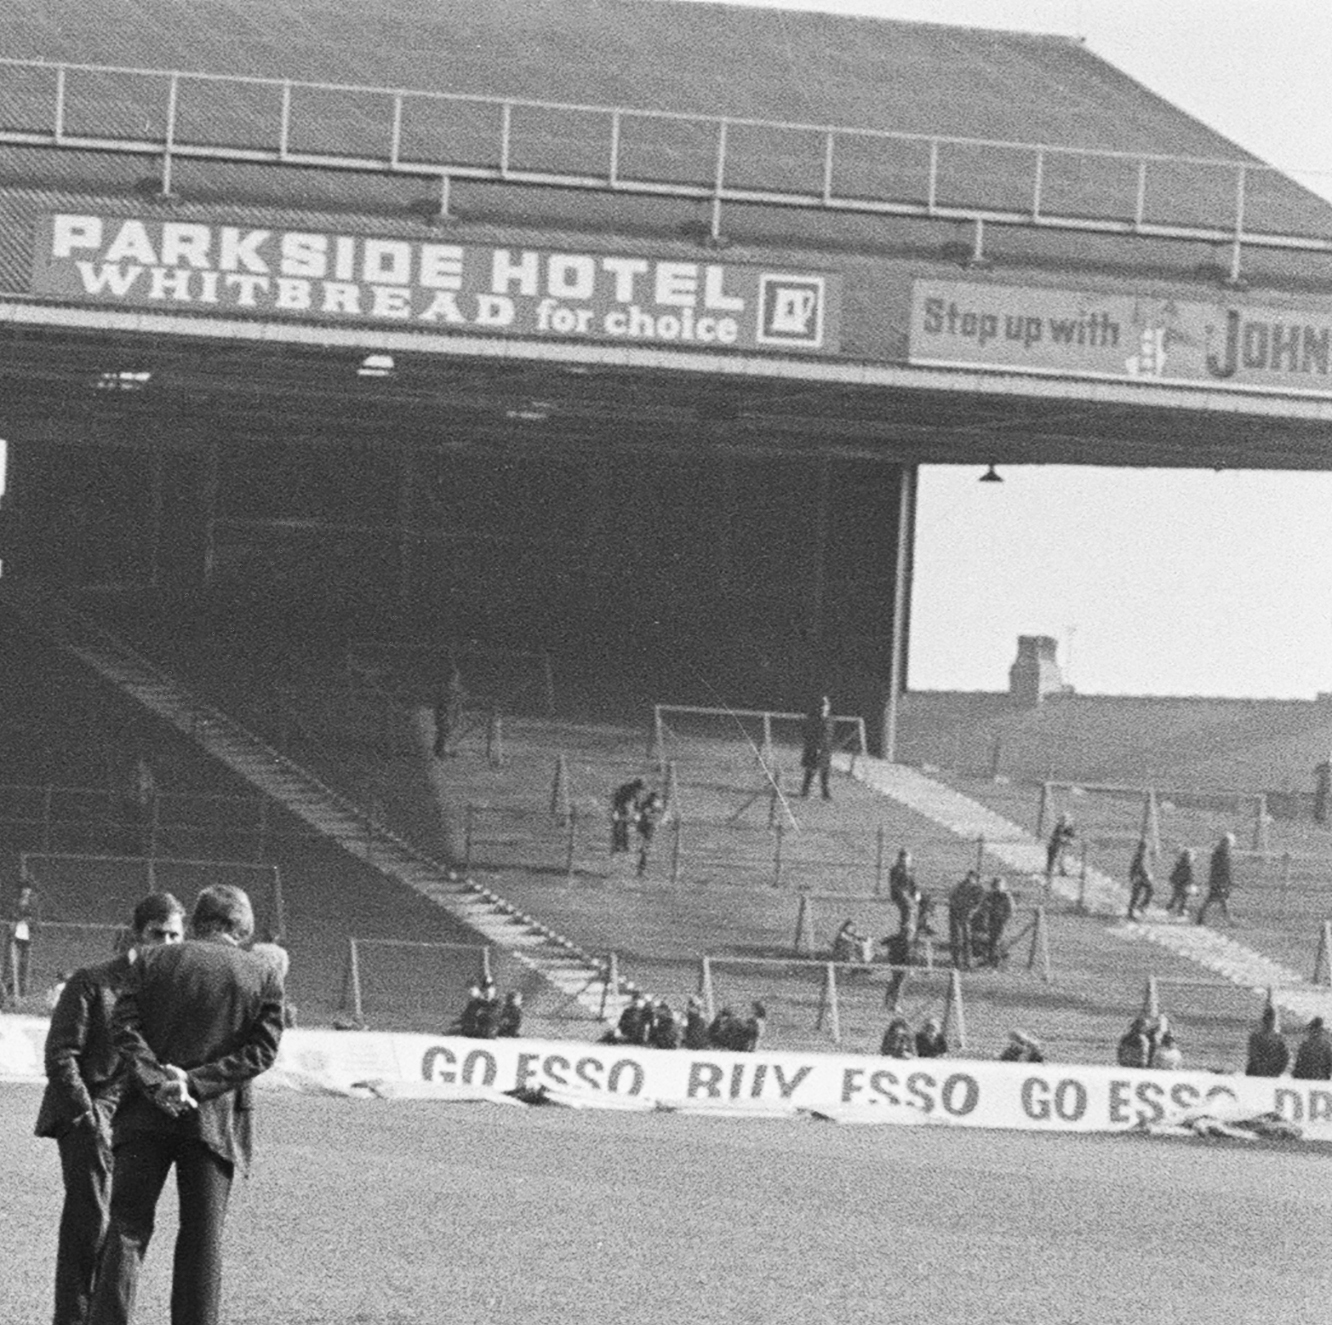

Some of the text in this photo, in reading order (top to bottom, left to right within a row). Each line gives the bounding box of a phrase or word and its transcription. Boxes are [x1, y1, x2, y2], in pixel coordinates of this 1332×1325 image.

[52, 213, 745, 312] PARKSIDE HOTEL
[74, 260, 738, 344] WHITBREAD for choice
[923, 297, 1121, 349] Step up with
[421, 1045, 498, 1087] GO
[515, 1051, 645, 1098] ESSO
[841, 1067, 981, 1116] ESSO
[1021, 1076, 1087, 1121] GO
